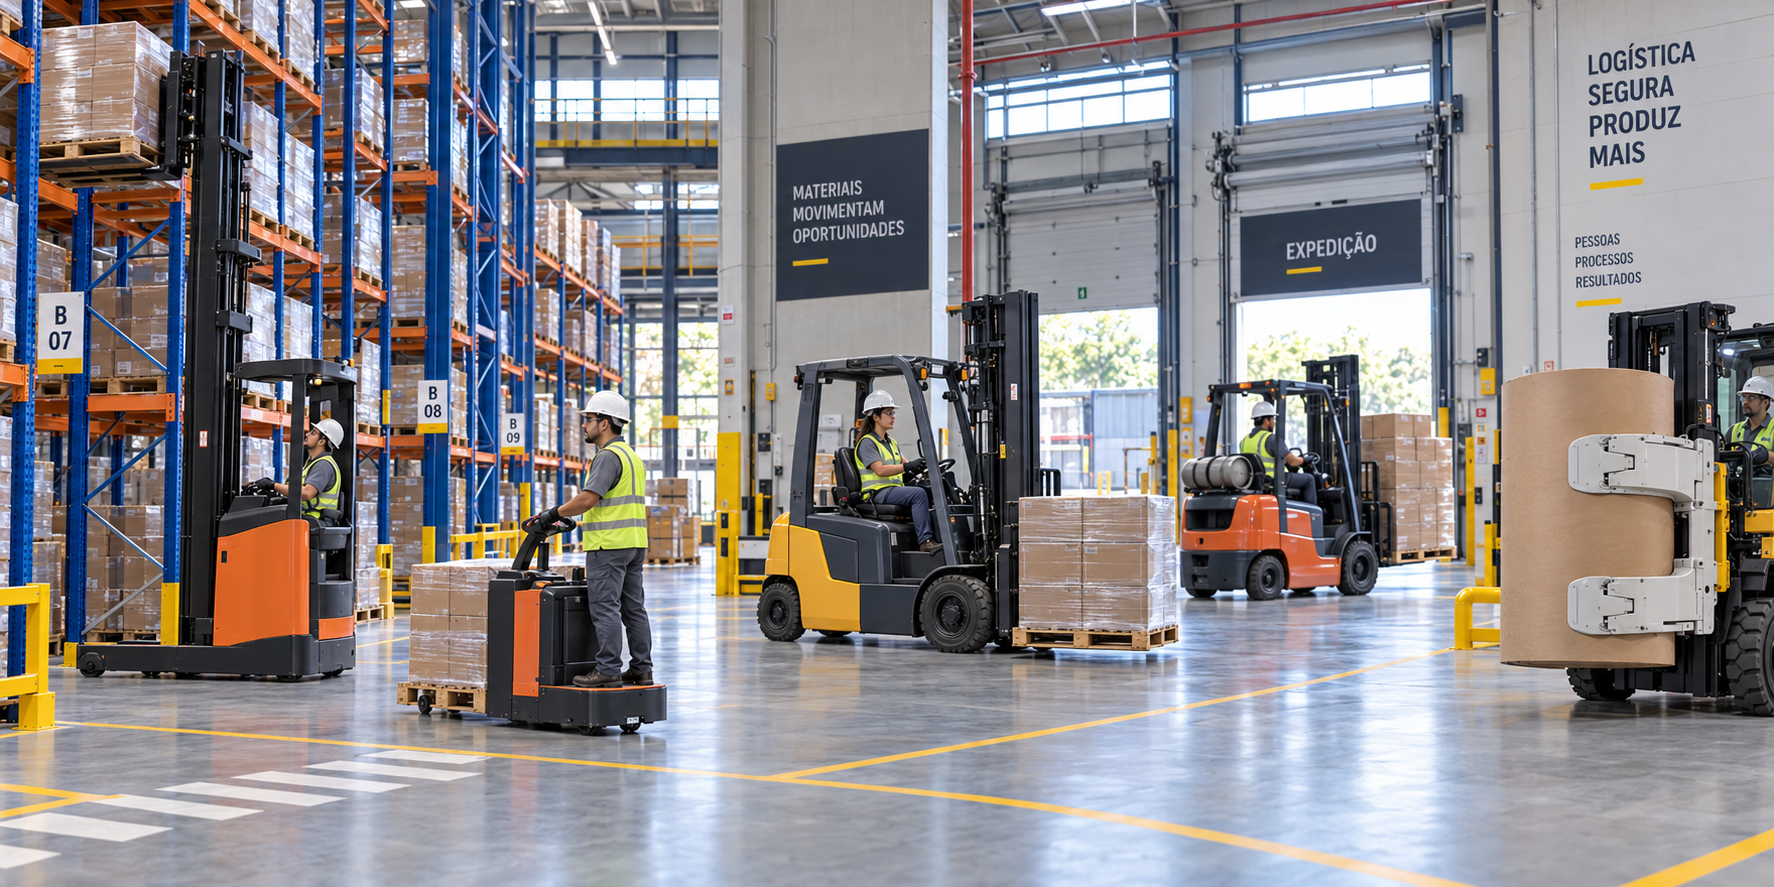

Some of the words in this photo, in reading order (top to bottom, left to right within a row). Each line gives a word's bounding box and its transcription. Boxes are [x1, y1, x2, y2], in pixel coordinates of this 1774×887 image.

[1588, 41, 1695, 75] LOGÍSTICA
[1588, 74, 1675, 107] SEGURA
[1589, 105, 1682, 138] PRODUZ
[1589, 140, 1646, 169] MAIS
[793, 179, 863, 201] MATERIAIS
[793, 199, 884, 222] MOVIMENTAM
[792, 219, 905, 244] OPORTUNIDADES
[1574, 232, 1621, 249] PESSOAS
[1286, 231, 1377, 261] EXPEDIÇÃO
[1575, 251, 1634, 269] PROCESSOS
[1575, 271, 1642, 289] RESULTADOS
[54, 305, 68, 326] B
[48, 330, 73, 351] 07
[428, 386, 437, 400] B
[424, 404, 442, 418] 08
[509, 418, 517, 429] B
[506, 432, 520, 443] 09
